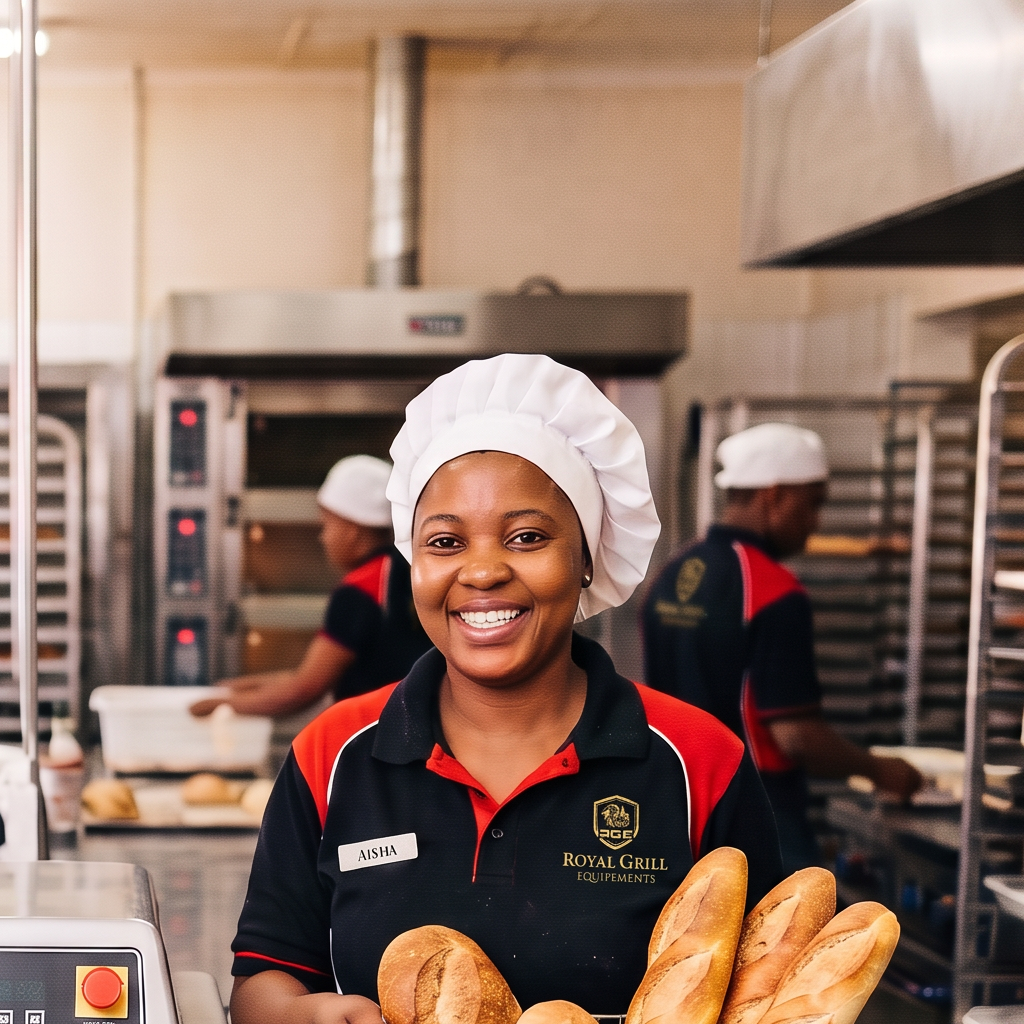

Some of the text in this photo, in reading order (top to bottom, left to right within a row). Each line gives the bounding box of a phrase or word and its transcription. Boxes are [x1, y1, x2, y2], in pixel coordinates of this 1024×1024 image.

[358, 844, 398, 862] AISHA
[562, 851, 669, 871] ROYAL GRILL
[577, 871, 656, 884] EQUIPEMENTS
